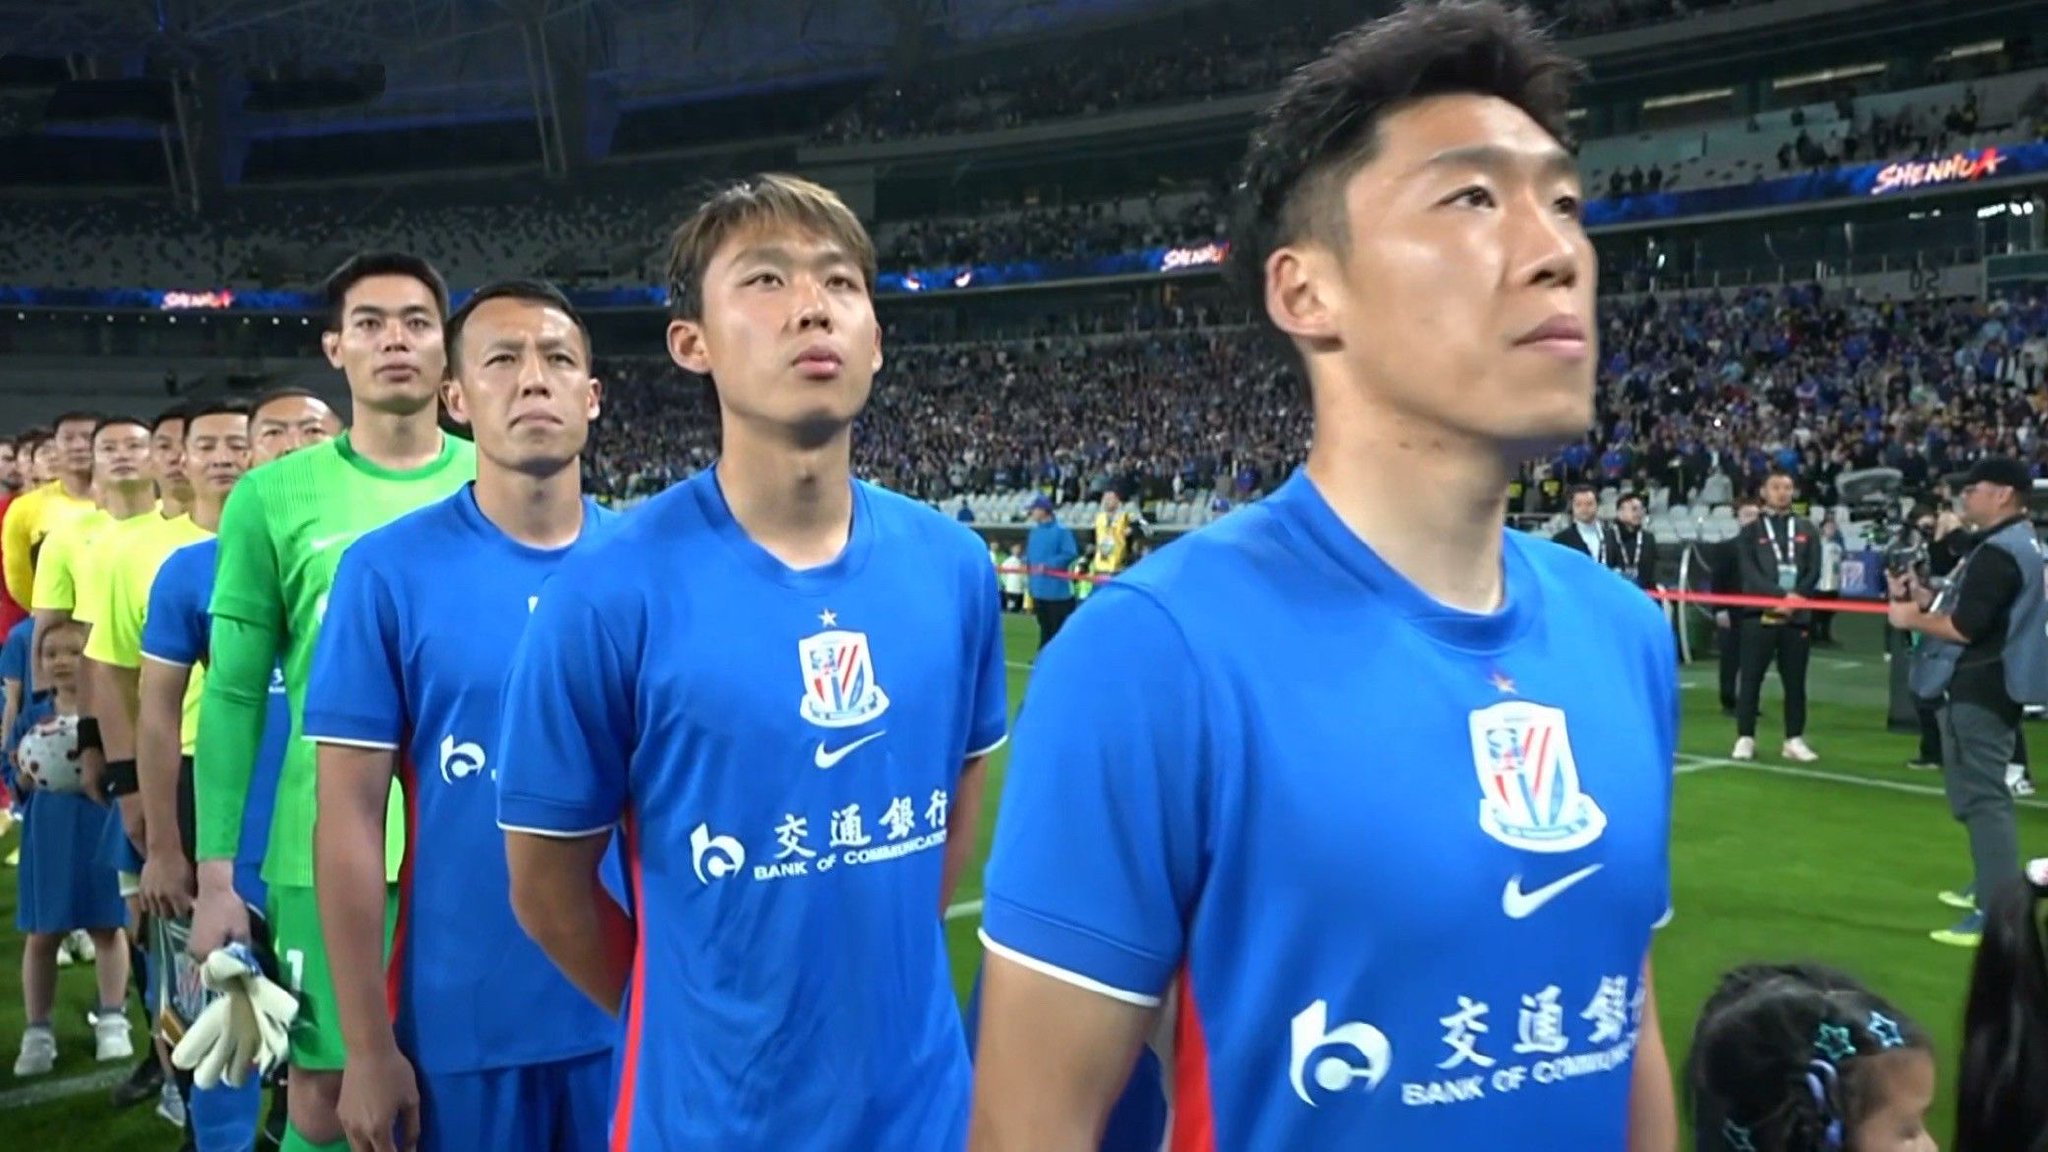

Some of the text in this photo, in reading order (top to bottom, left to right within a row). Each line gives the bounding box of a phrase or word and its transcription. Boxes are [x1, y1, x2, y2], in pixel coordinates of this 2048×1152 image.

[1871, 148, 2007, 194] SHENHUA
[754, 861, 809, 881] BANK
[816, 853, 837, 872] OF
[1402, 1075, 1485, 1106] BANK
[1491, 1065, 1528, 1092] OF
